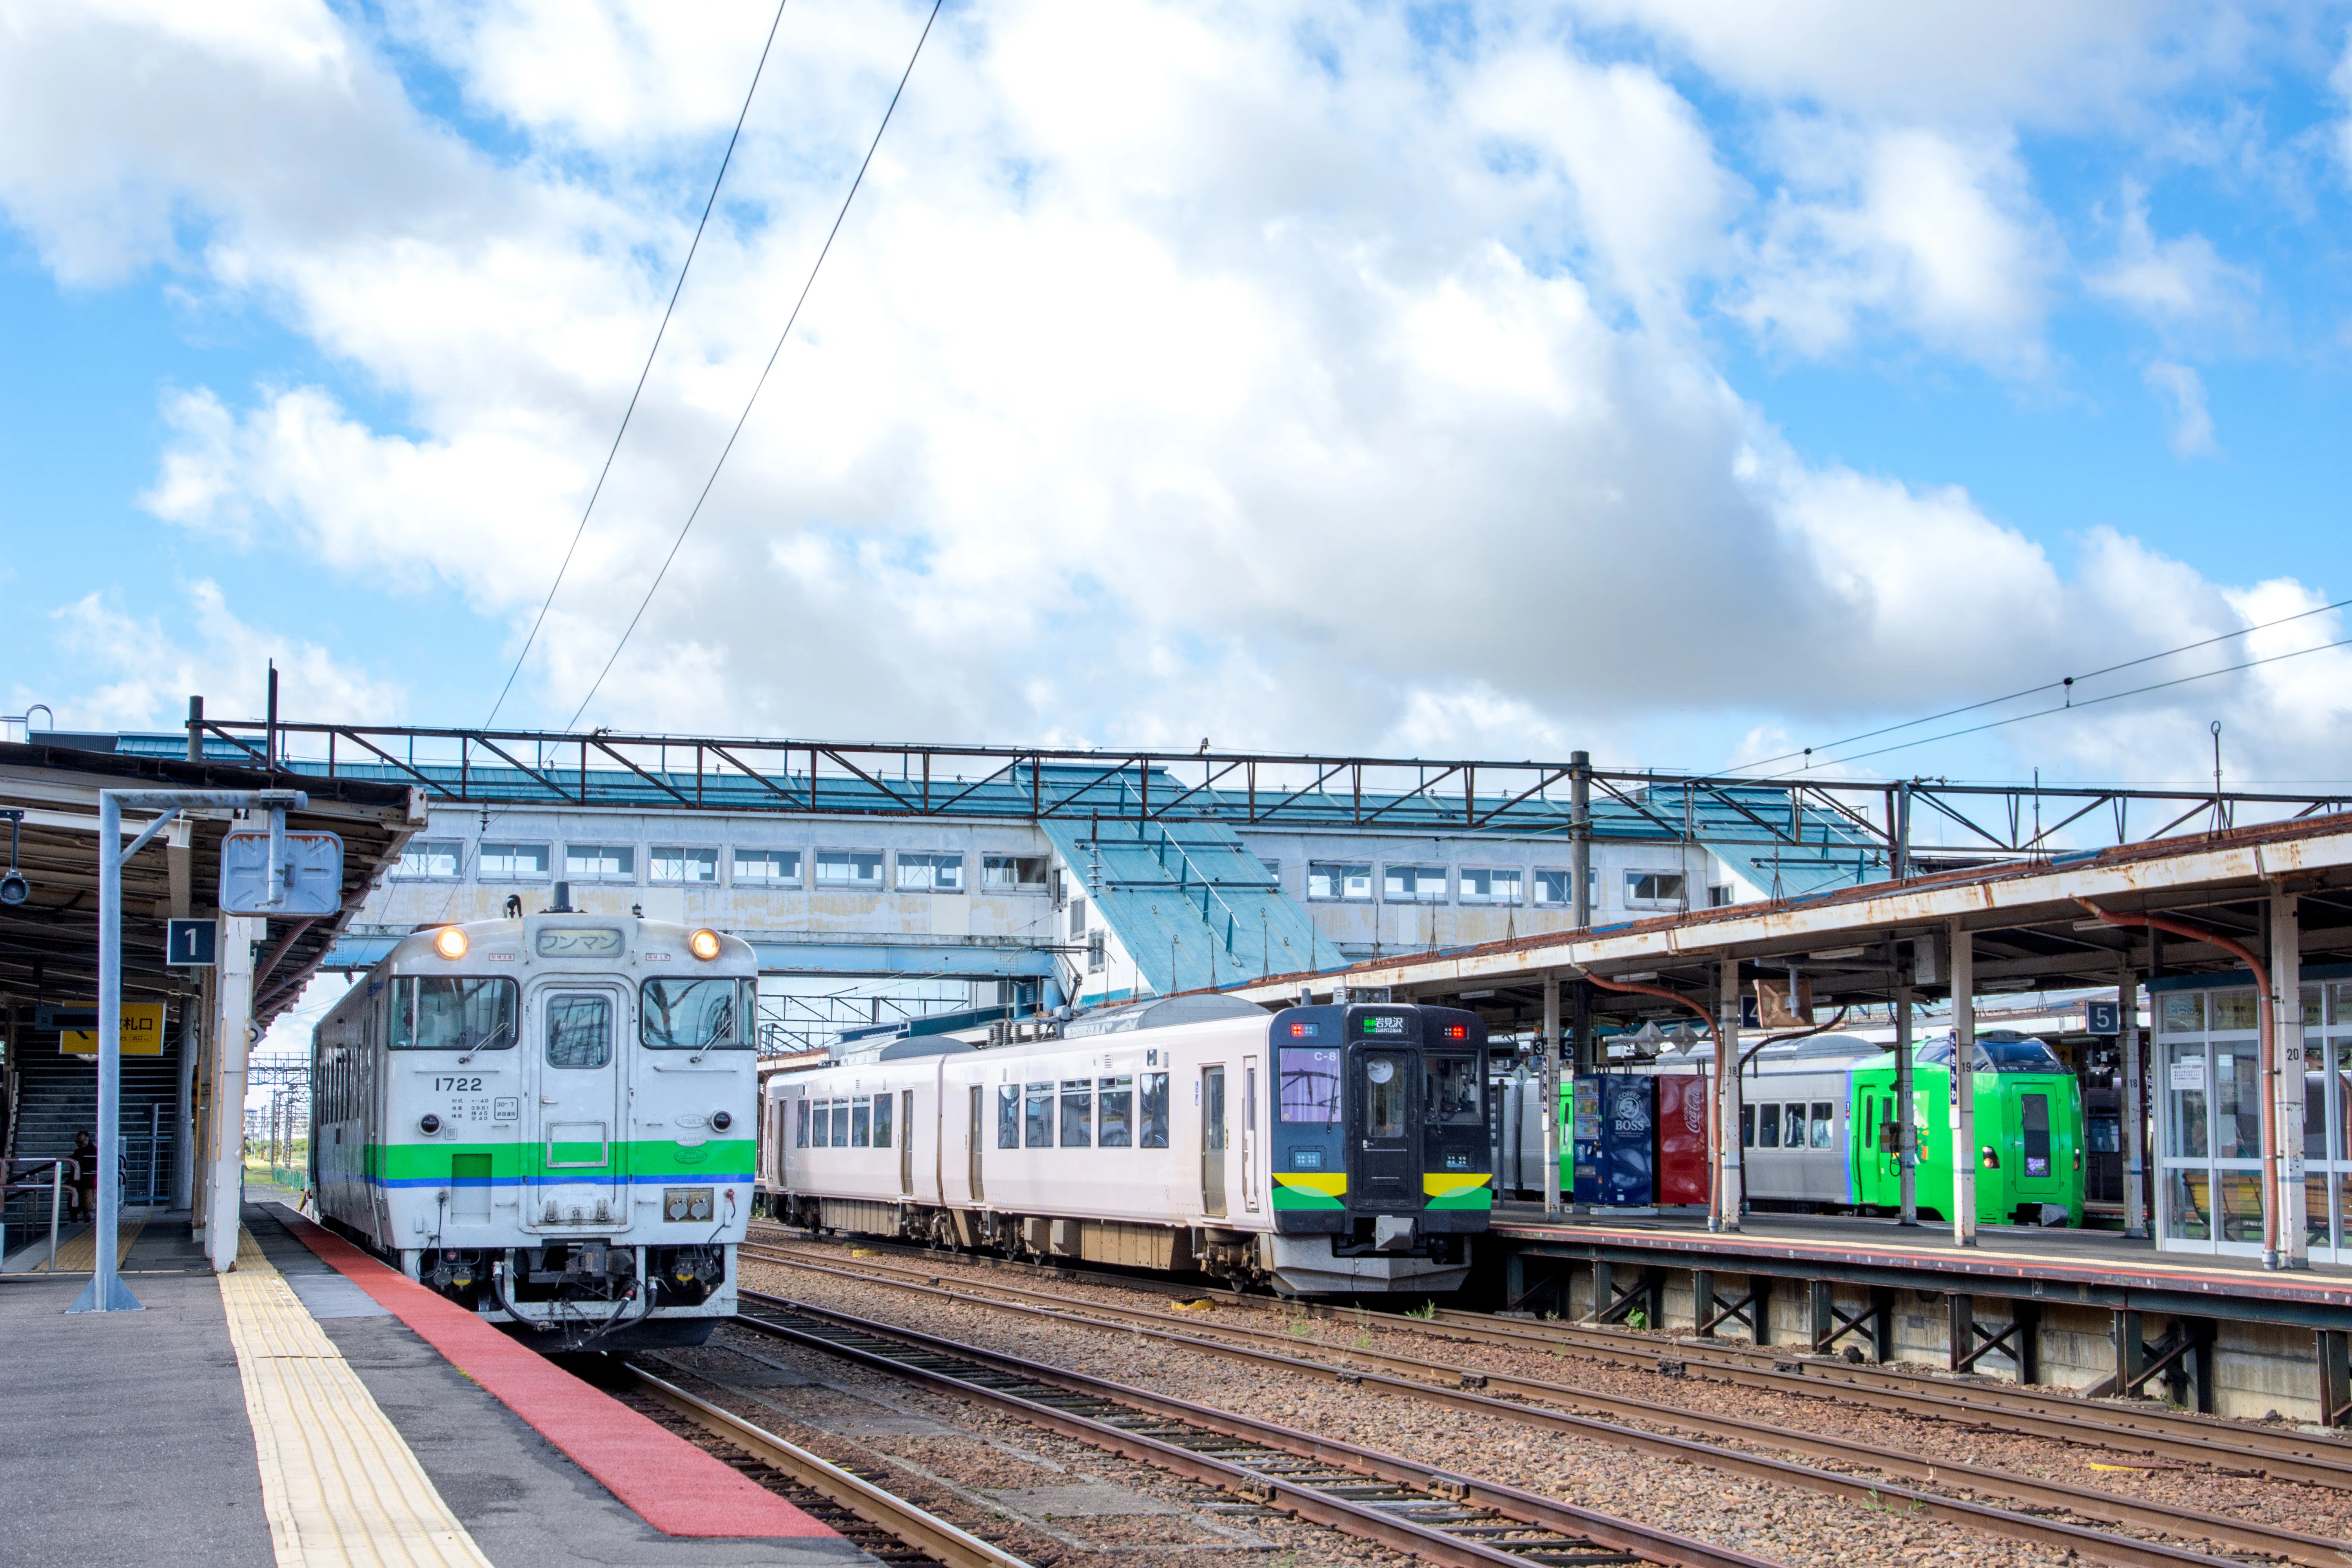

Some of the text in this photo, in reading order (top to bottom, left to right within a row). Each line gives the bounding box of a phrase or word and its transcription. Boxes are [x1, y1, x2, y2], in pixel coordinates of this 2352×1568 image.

[185, 928, 196, 955] 1
[541, 936, 619, 949] ワンマン
[1375, 1017, 1403, 1028] 岩見沢
[2096, 1007, 2110, 1027] 5
[119, 1017, 152, 1030] 札口
[1535, 1042, 1543, 1054] 3
[1564, 1041, 1573, 1056] 5
[1314, 1052, 1336, 1061] C-8
[2287, 1048, 2299, 1061] 20
[1729, 1066, 1737, 1075] 18
[1962, 1062, 1971, 1073] 19
[436, 1078, 482, 1091] 1722
[1551, 1076, 1558, 1085] 17
[2130, 1079, 2138, 1088] 18
[1618, 1091, 1641, 1100] COFFEE
[1615, 1120, 1644, 1130] BOSS
[2034, 1281, 2043, 1294] 20
